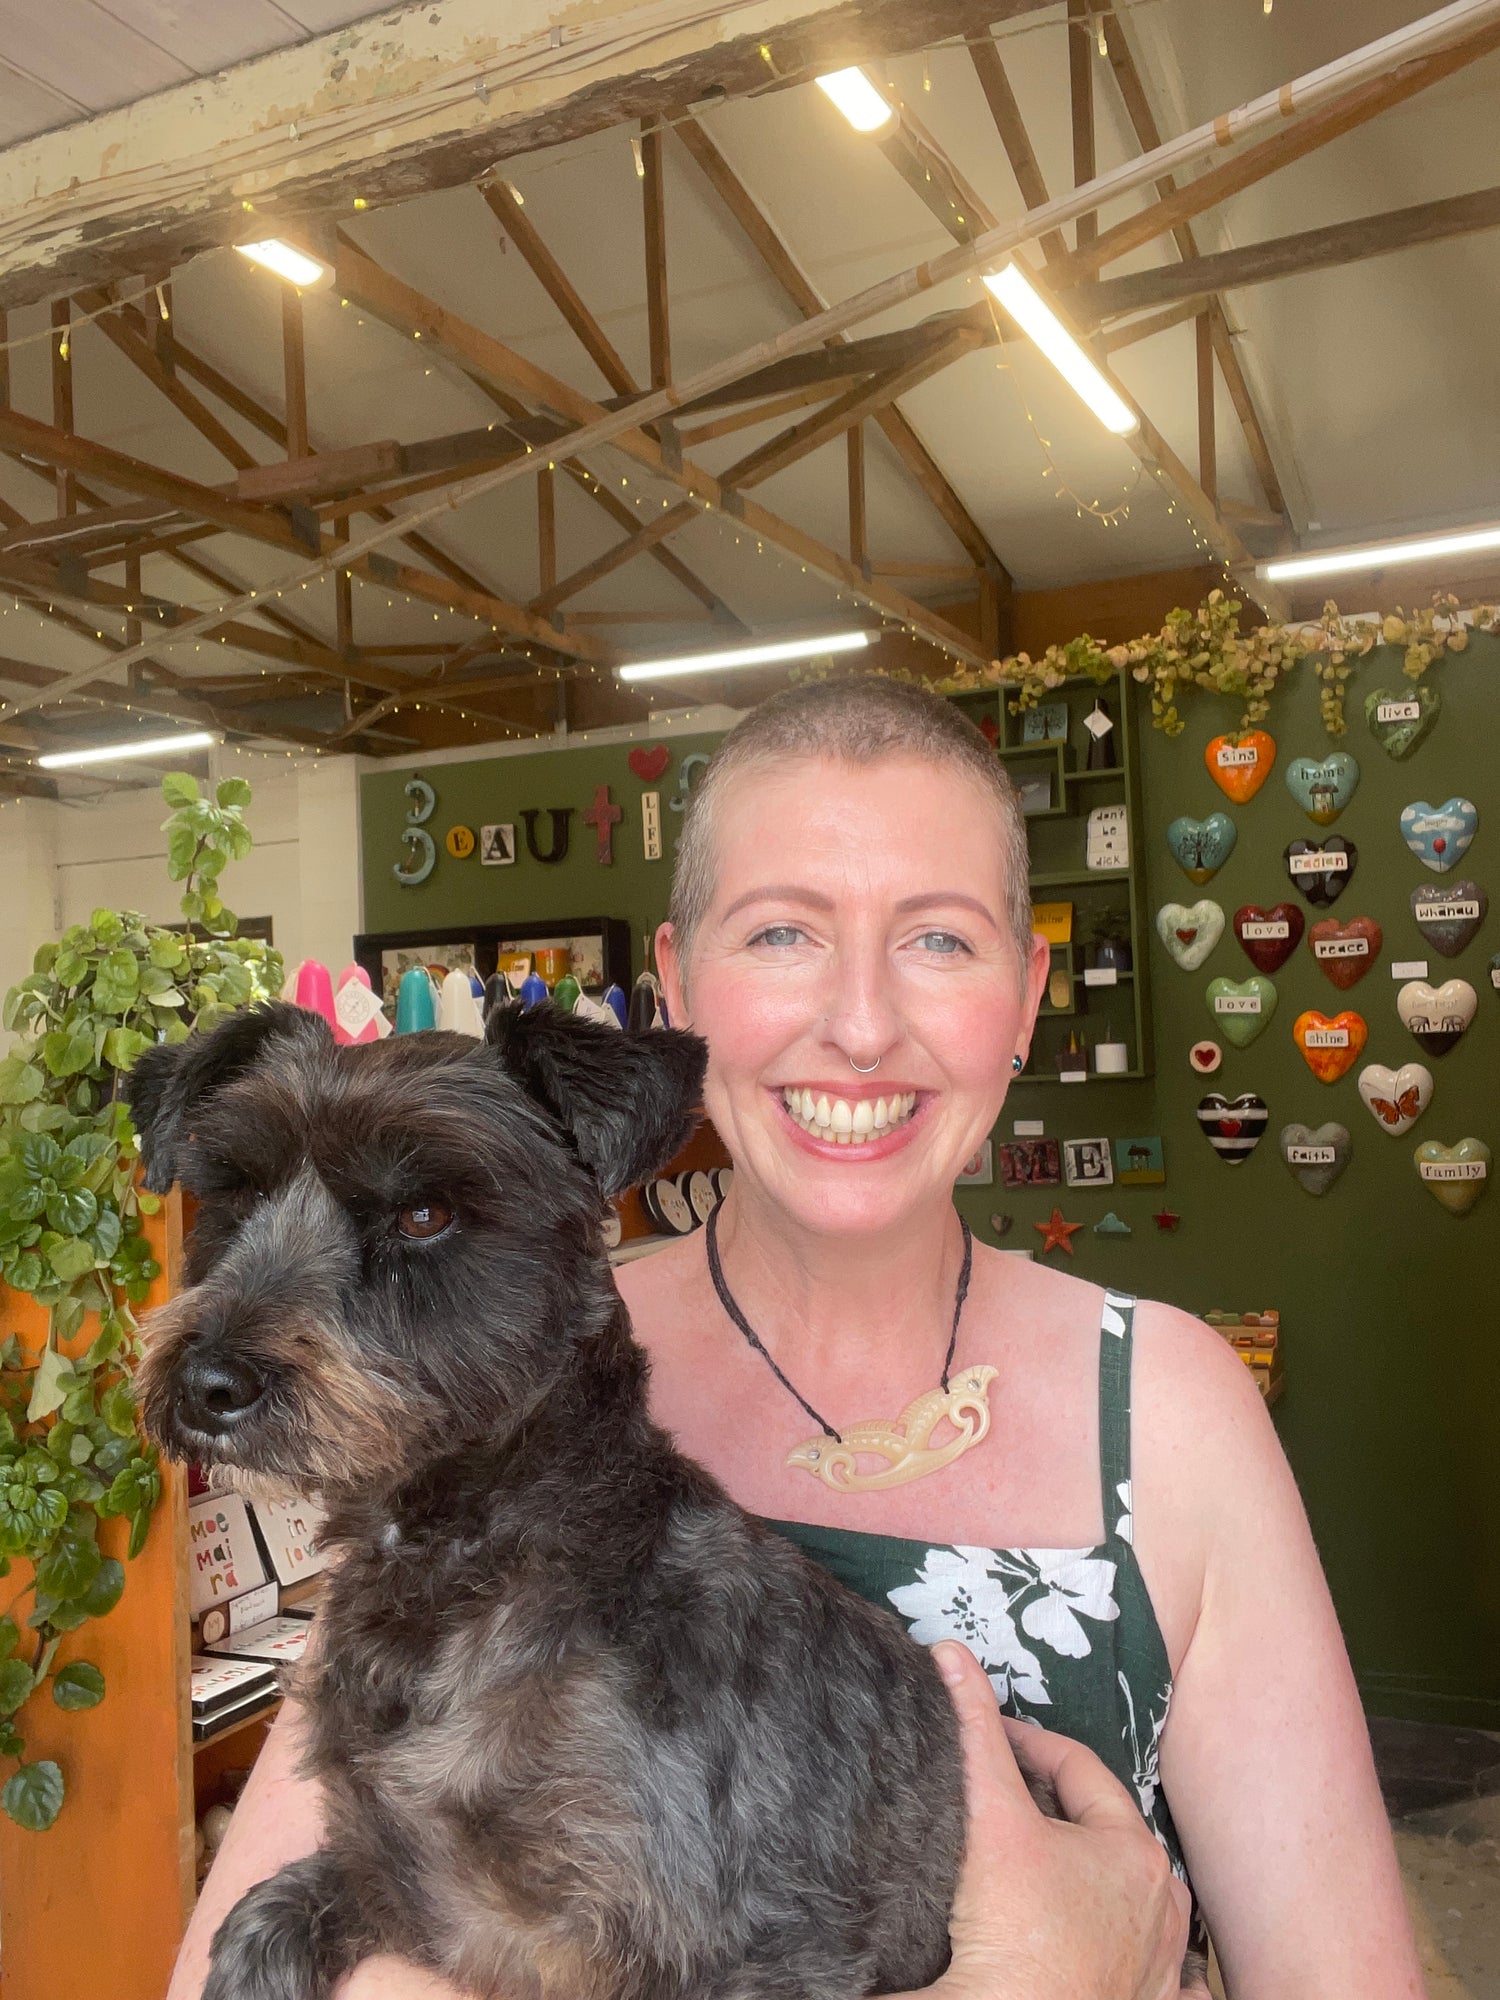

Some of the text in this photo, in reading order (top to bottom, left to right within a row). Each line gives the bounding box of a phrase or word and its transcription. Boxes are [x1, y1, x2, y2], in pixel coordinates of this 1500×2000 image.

[1383, 706, 1413, 718] live
[1300, 766, 1345, 780] home
[644, 795, 660, 857] LIFE
[1102, 824, 1117, 836] be
[1105, 841, 1113, 849] a
[1096, 855, 1120, 866] dick
[1419, 906, 1473, 917] whānau
[1246, 926, 1286, 935] love
[1319, 942, 1366, 956] peace
[1218, 999, 1258, 1009] love
[1309, 1034, 1344, 1045] shine
[1292, 1150, 1330, 1160] faith
[1425, 1165, 1481, 1178] family
[286, 1517, 308, 1539] in
